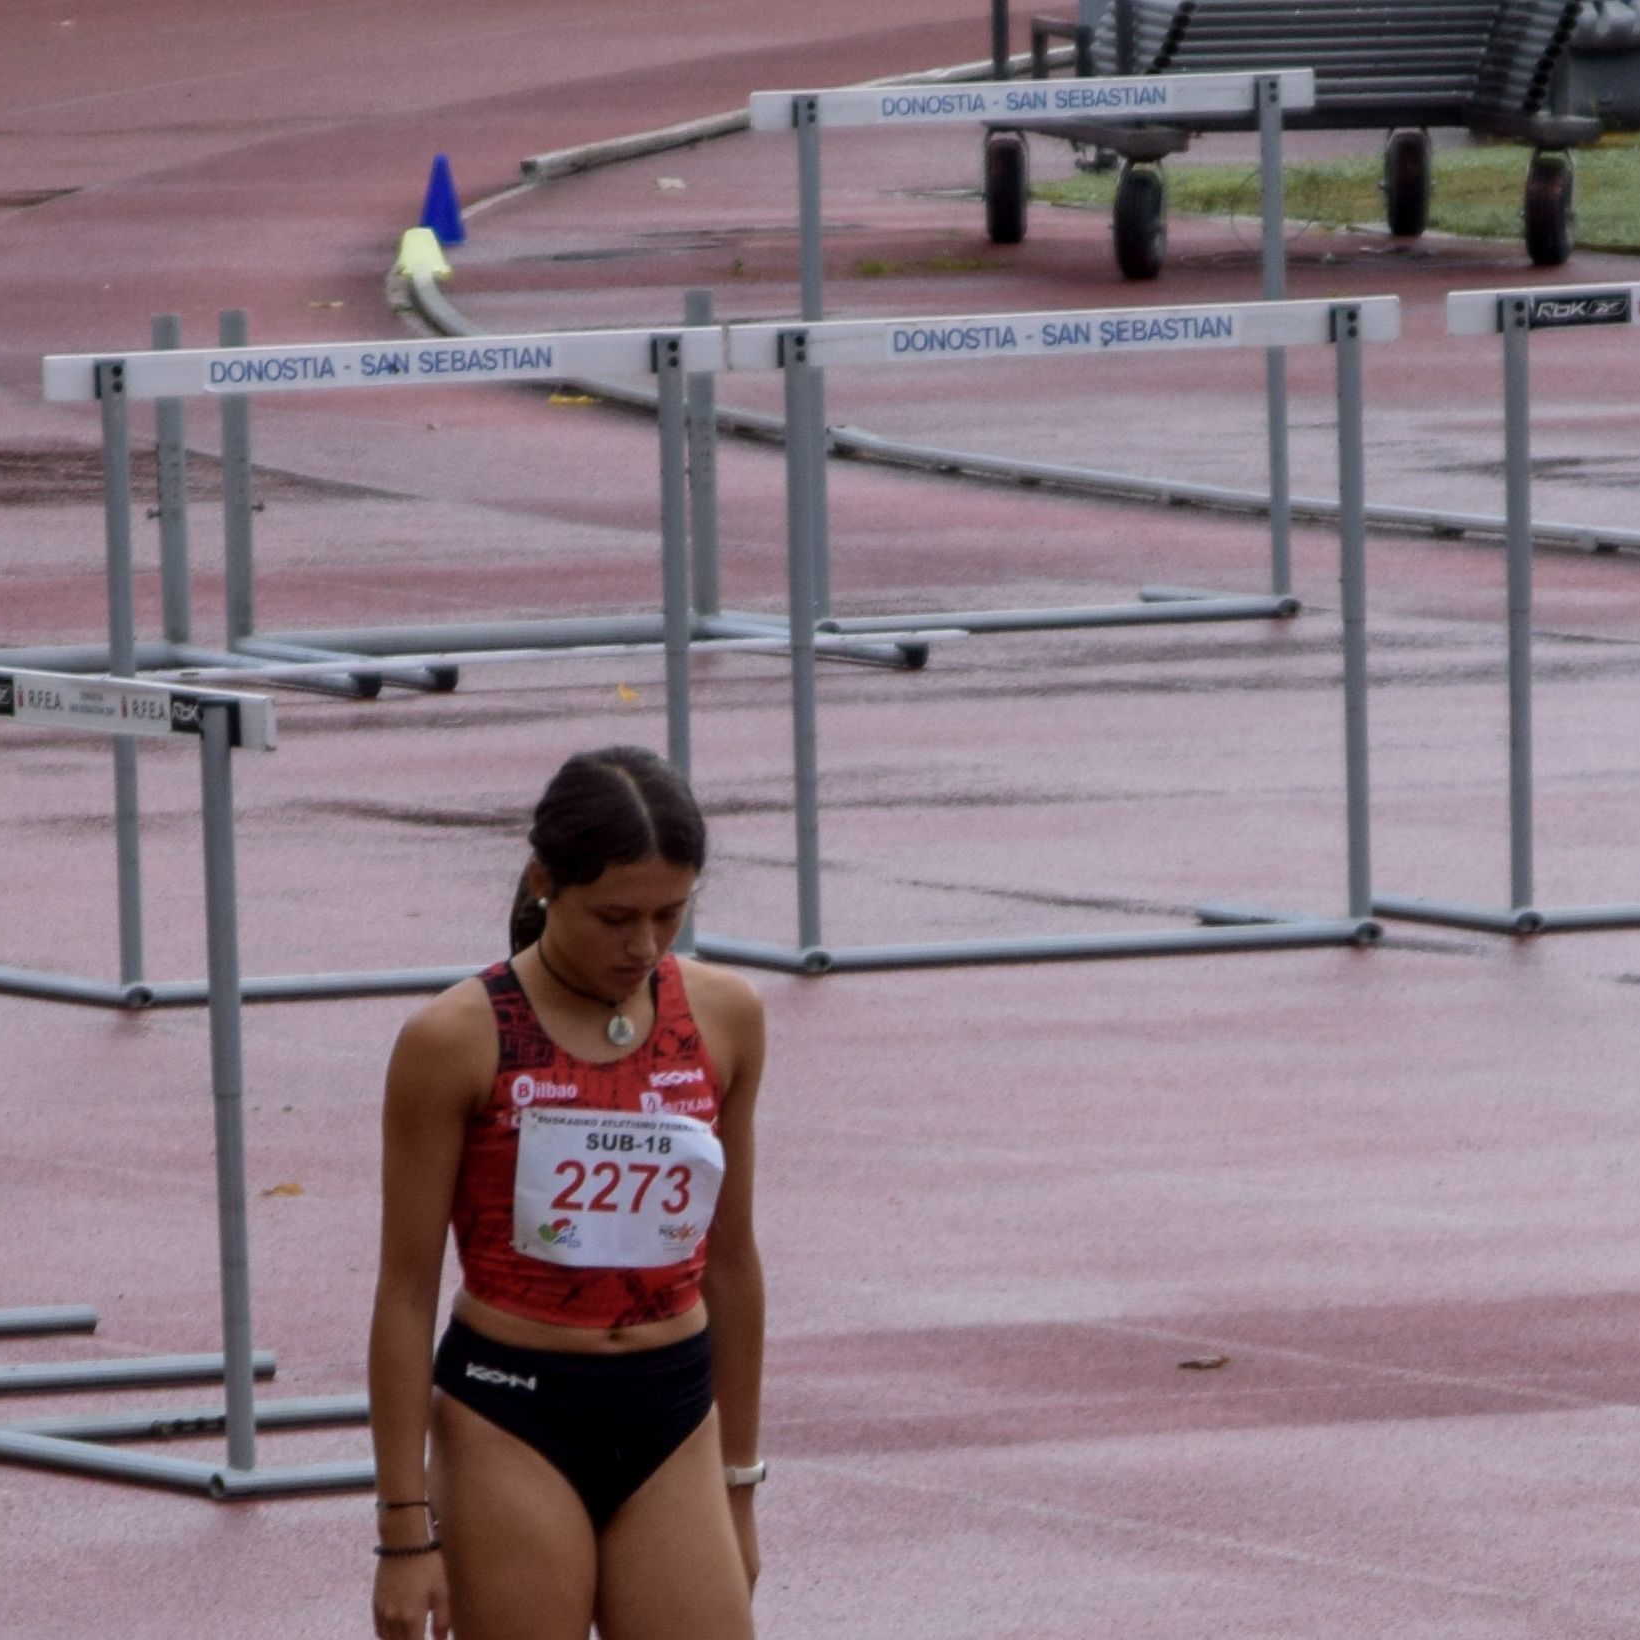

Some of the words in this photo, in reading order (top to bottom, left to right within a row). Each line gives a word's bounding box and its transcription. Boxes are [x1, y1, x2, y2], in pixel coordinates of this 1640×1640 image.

[881, 93, 986, 117] DONOSTIA
[1005, 89, 1048, 111] SAN
[1054, 85, 1168, 109] SEBASTIAN
[892, 326, 1018, 354] DONOSTIA
[1041, 322, 1092, 347] SAN
[1099, 316, 1233, 346] SEBASTIAN
[209, 357, 337, 385] DONOSTIA
[359, 350, 410, 377] SAN
[417, 346, 553, 375] SEBASTIAN
[514, 1077, 578, 1102] Bilbao
[586, 1132, 672, 1155] SUB-18
[549, 1159, 692, 1215] 2273
